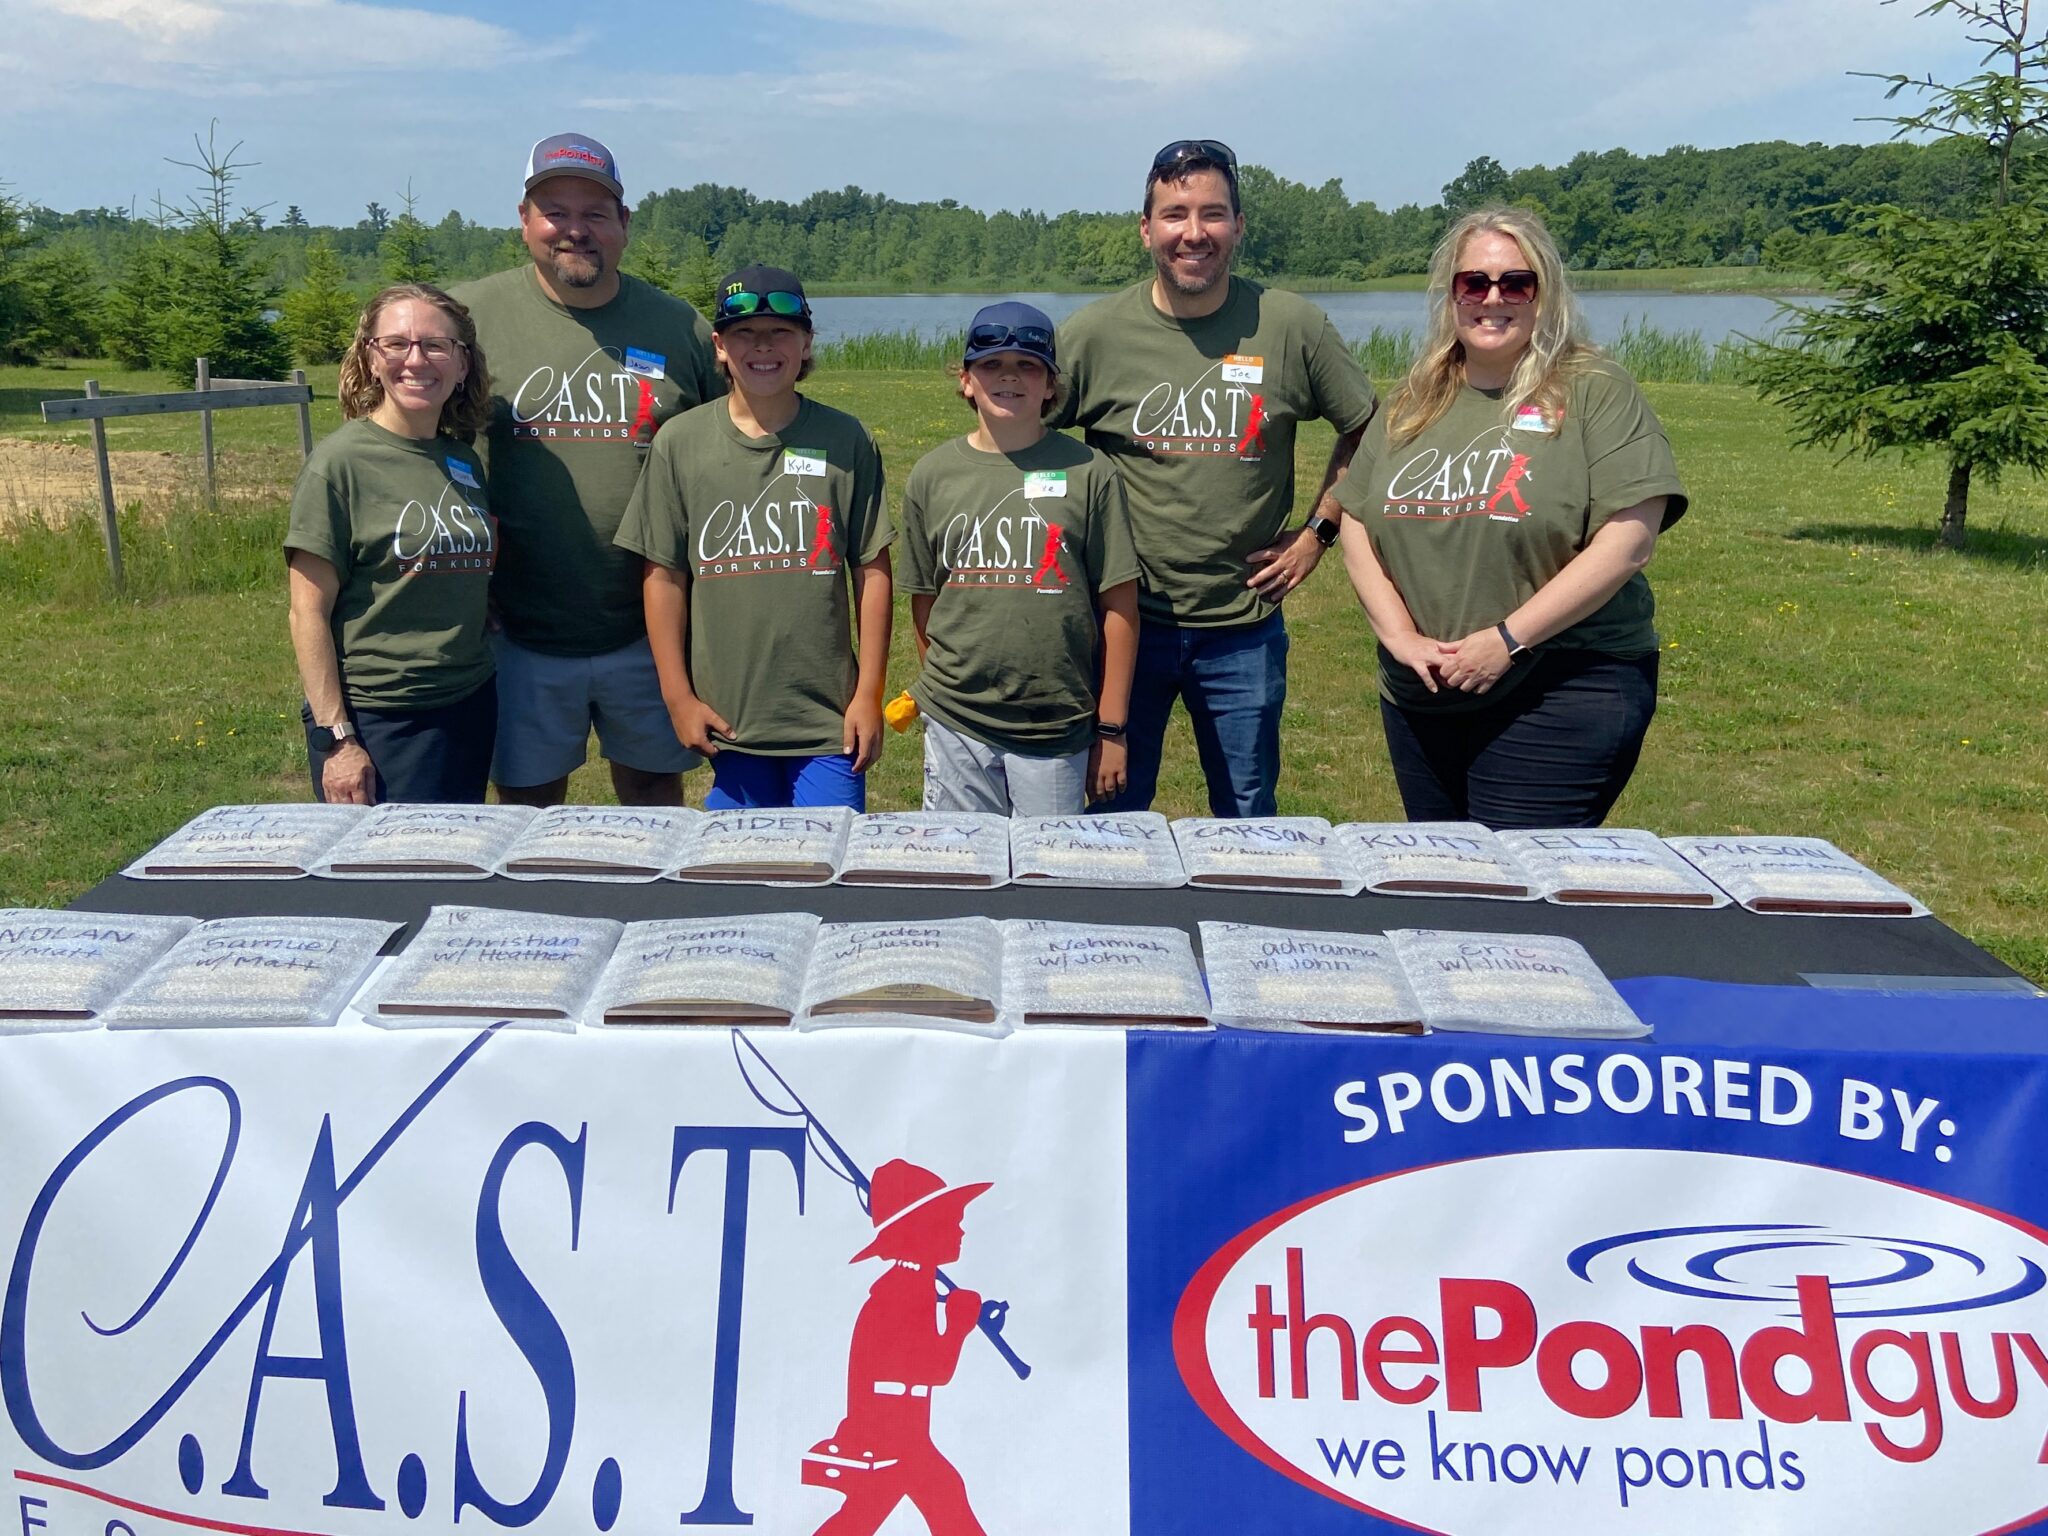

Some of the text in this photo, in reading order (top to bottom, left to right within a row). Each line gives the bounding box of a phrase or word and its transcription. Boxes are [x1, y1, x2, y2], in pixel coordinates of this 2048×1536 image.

[1230, 368, 1251, 379] Joe
[512, 366, 632, 424] C.A.S.T
[1132, 382, 1245, 438] C.A.S.T
[513, 427, 629, 438] FOR KIDS
[1133, 440, 1236, 452] FOR KIDS
[788, 459, 813, 473] Kyle
[1387, 448, 1509, 501] C.A.S.T
[1383, 500, 1486, 516] FOR KIDS
[1488, 514, 1519, 523] Foundation
[698, 500, 811, 562] C.A.S.T
[942, 513, 1041, 571] C.A.S.T
[398, 558, 491, 574] FOR KIDS
[699, 557, 807, 576] FOR KIDS
[979, 574, 1033, 584] KIDS
[542, 814, 672, 829] JUDAH
[865, 813, 898, 821] #5
[701, 816, 834, 837] AIDEN
[862, 823, 982, 840] JOEY
[1039, 820, 1157, 840] MIKEY
[1193, 824, 1328, 846] CARSON
[903, 842, 979, 855] Austin
[1069, 839, 1139, 852] Austin
[1360, 833, 1482, 850] KURT
[1529, 835, 1638, 851] ELI
[1694, 843, 1834, 861] MASON
[0, 926, 135, 944] NOLAN
[446, 934, 582, 949] Christian
[850, 926, 941, 944] Caden
[201, 935, 340, 954] Samuel
[642, 943, 781, 963] w/ Theresa
[834, 941, 863, 960] w/
[1048, 937, 1171, 954] Nehmiah
[1458, 943, 1538, 959] Eric
[196, 953, 321, 972] w/ Matt
[433, 948, 582, 965] w/ Heather
[1038, 951, 1142, 973] w/ John
[1249, 958, 1351, 974] w/ John
[1437, 956, 1570, 976] w/ Jillian
[1332, 1052, 1958, 1163] SPONSORED BY:
[0, 1050, 806, 1533] C.A.S.T
[1315, 1410, 1806, 1508] we know ponds
